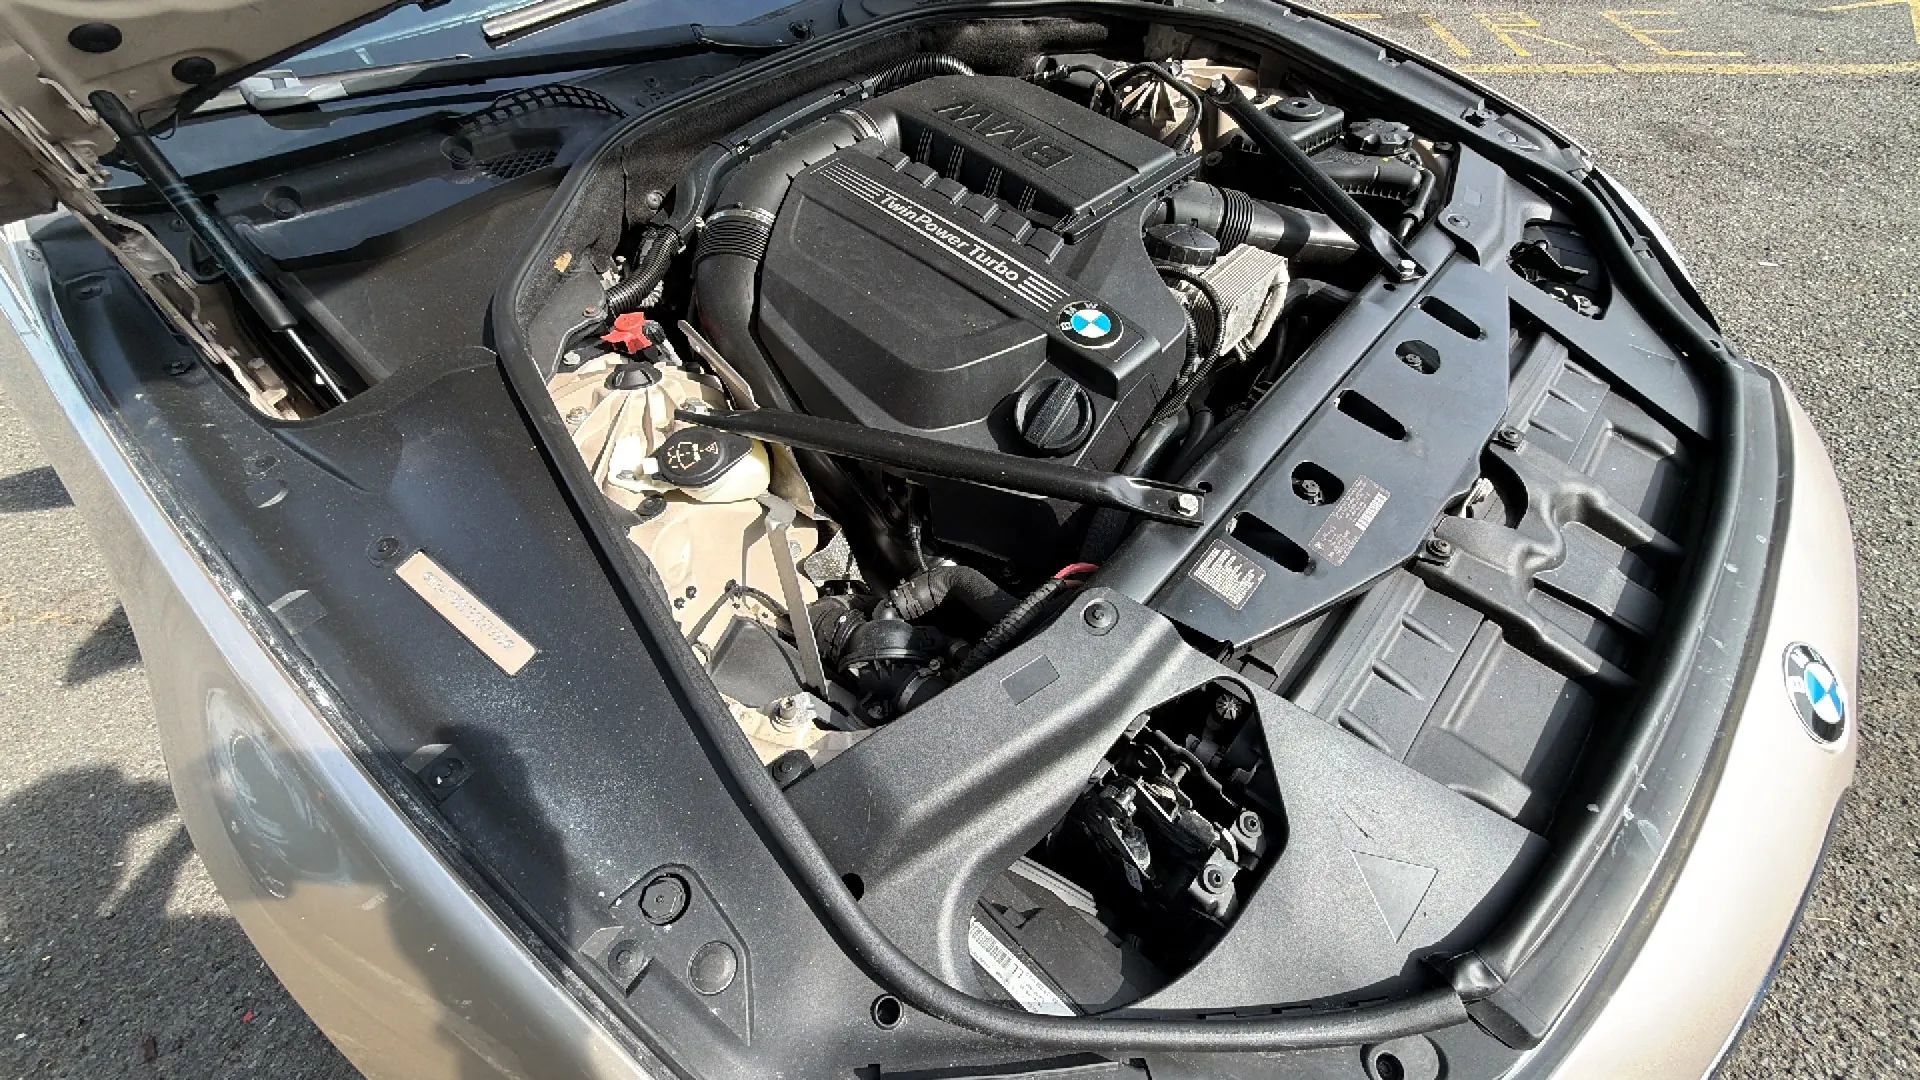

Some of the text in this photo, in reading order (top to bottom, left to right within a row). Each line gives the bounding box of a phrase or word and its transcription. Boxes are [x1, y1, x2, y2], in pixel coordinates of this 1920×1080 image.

[933, 101, 1075, 171] BMW
[880, 193, 1019, 281] TwinPower Turbo
